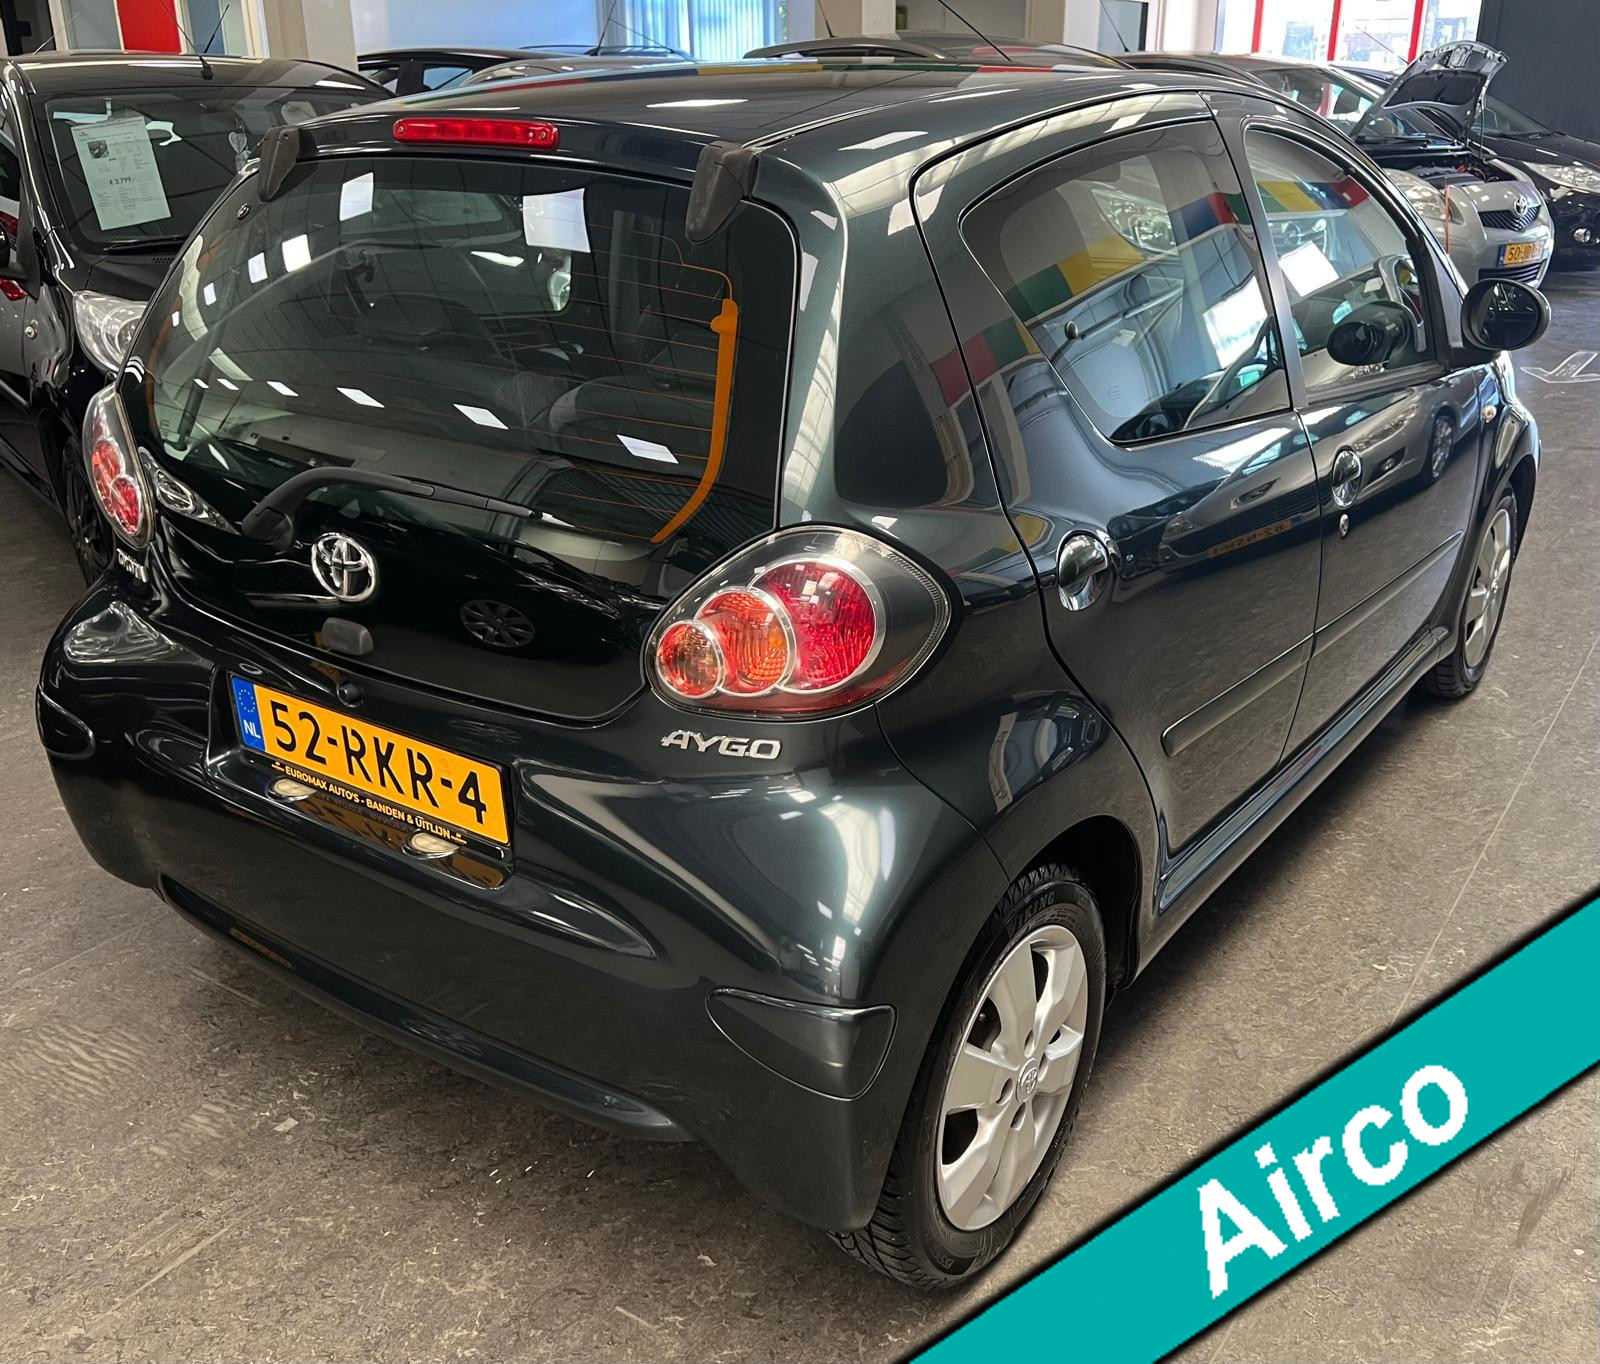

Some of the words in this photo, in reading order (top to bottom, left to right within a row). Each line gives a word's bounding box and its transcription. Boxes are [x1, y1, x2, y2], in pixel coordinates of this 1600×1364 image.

[243, 719, 262, 740] NL
[660, 729, 782, 760] AYGO
[270, 699, 488, 825] 52-RKR-4
[284, 765, 328, 791] EUROMAX
[328, 784, 360, 804] AUTO'S
[365, 798, 406, 822] BANDEN
[406, 814, 414, 825] &
